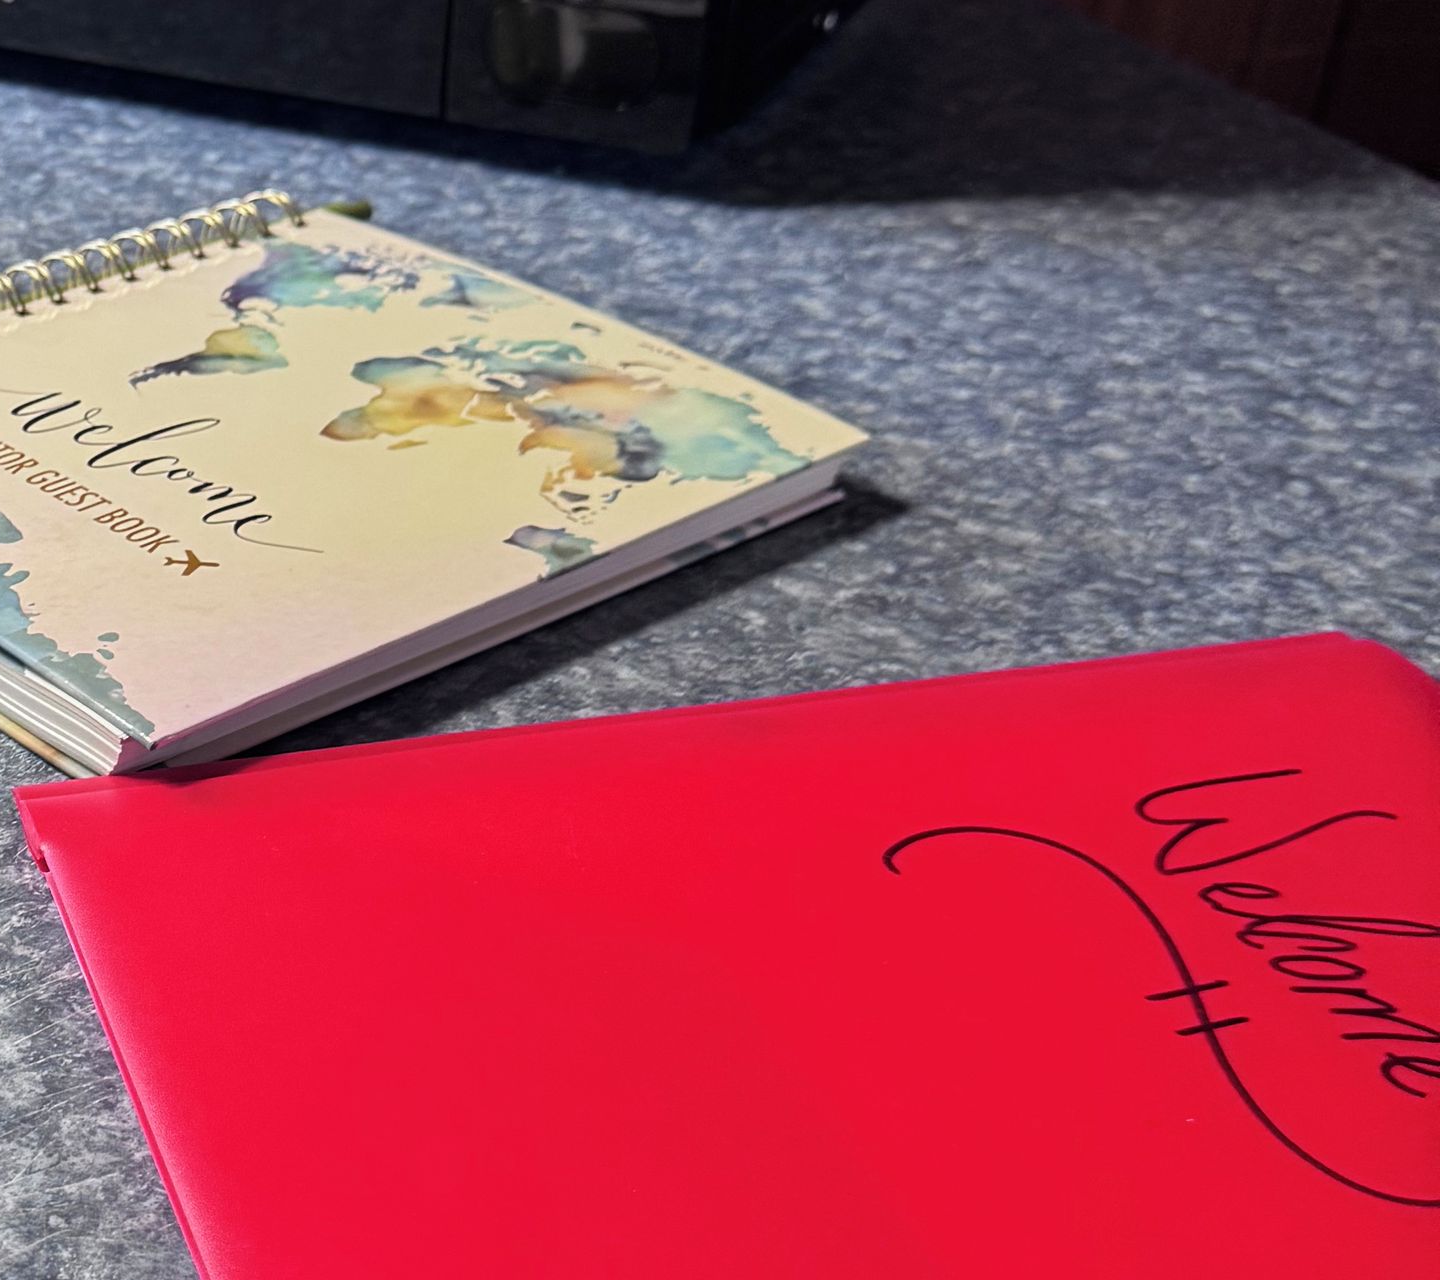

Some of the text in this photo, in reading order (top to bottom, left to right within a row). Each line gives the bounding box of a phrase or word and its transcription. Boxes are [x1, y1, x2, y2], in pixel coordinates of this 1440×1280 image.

[26, 469, 111, 513] GUEST
[93, 508, 180, 554] BOOK
[1134, 767, 1440, 1099] Welcome
